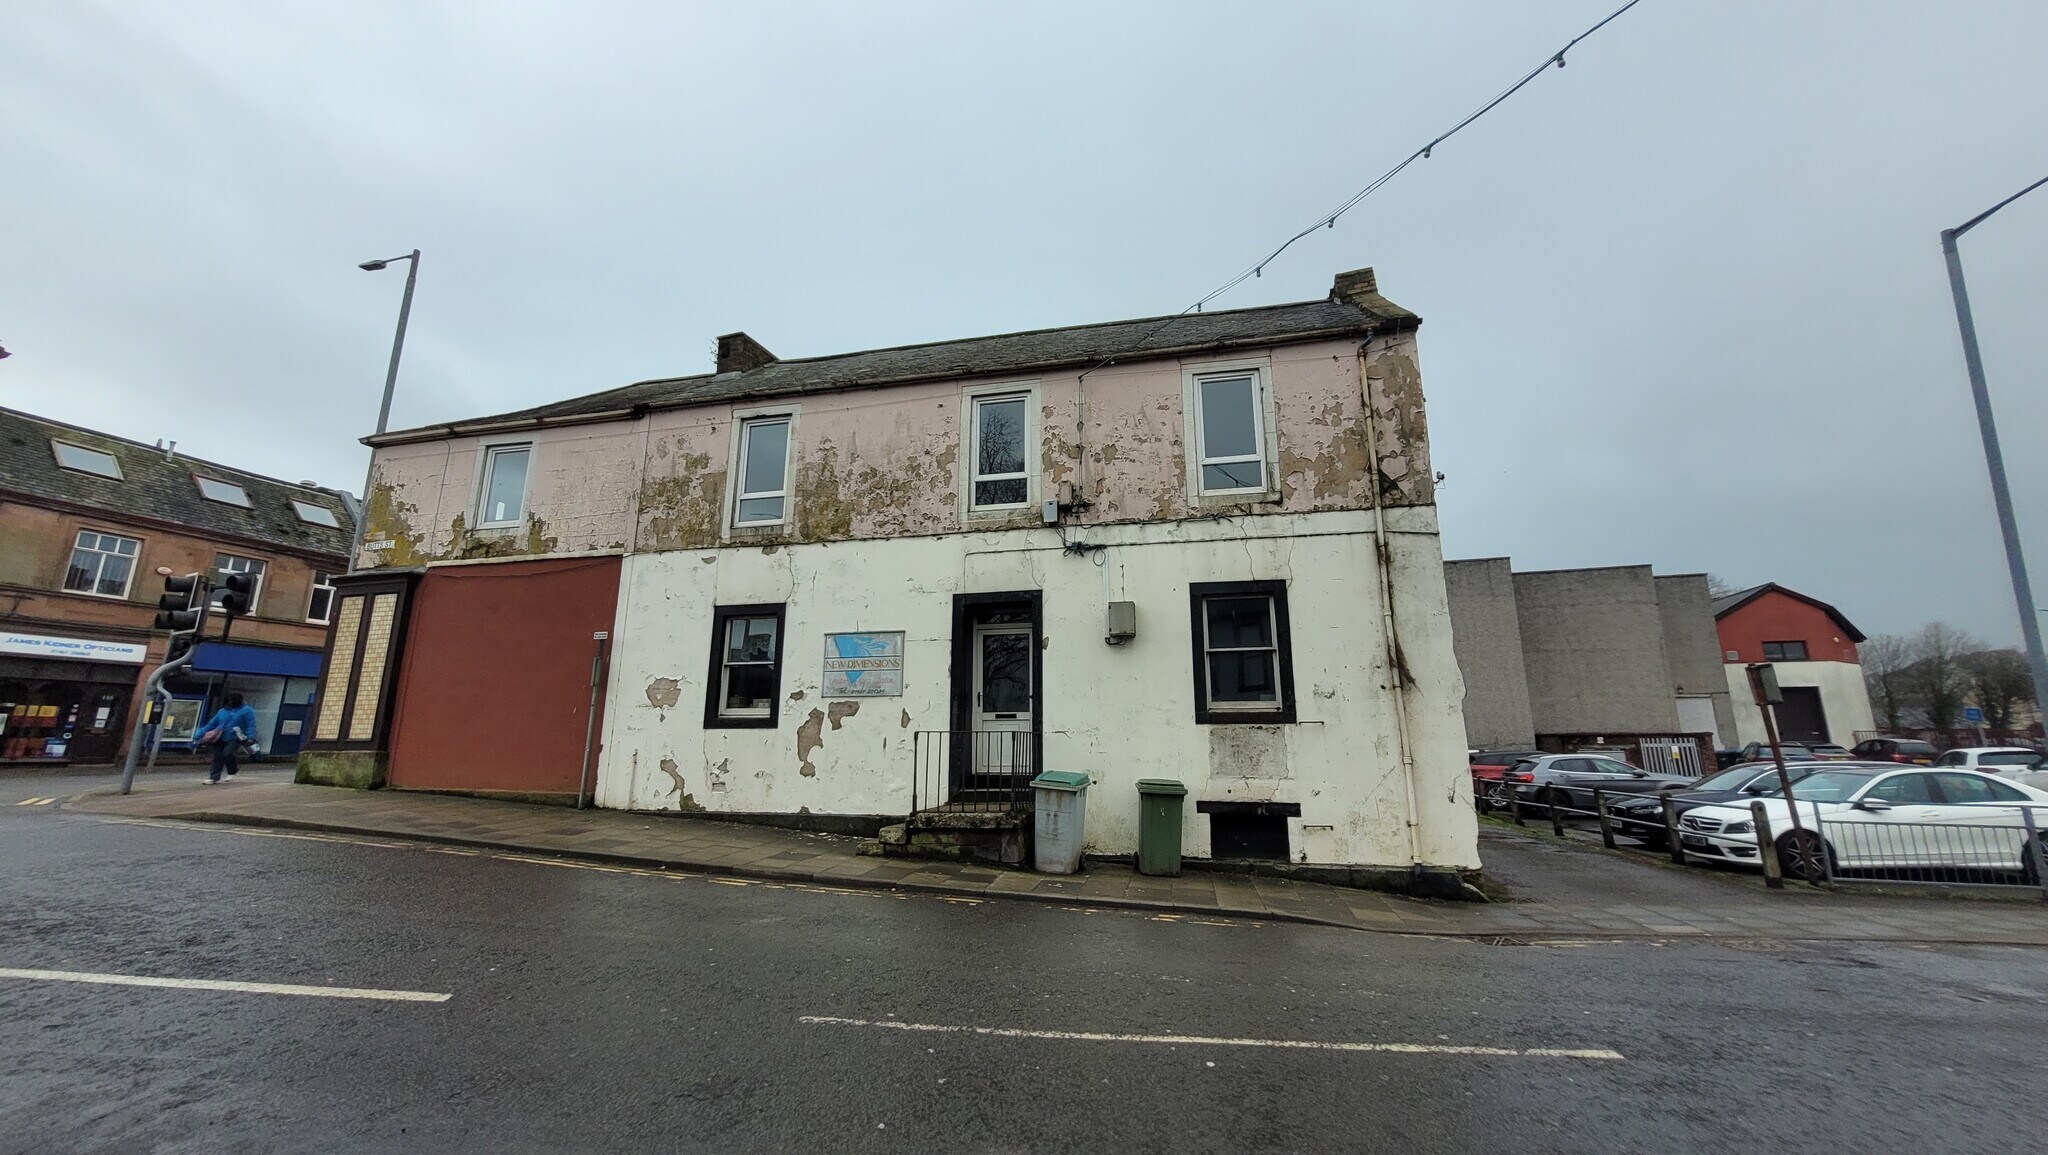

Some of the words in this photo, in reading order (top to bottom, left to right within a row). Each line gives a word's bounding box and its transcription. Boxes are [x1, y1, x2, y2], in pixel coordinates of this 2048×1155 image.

[367, 542, 384, 550] BUTTS
[5, 637, 41, 646] JAMES
[84, 643, 133, 653] OPTICIANS
[826, 660, 845, 669] NEW
[847, 659, 900, 668] DIMENSIONS
